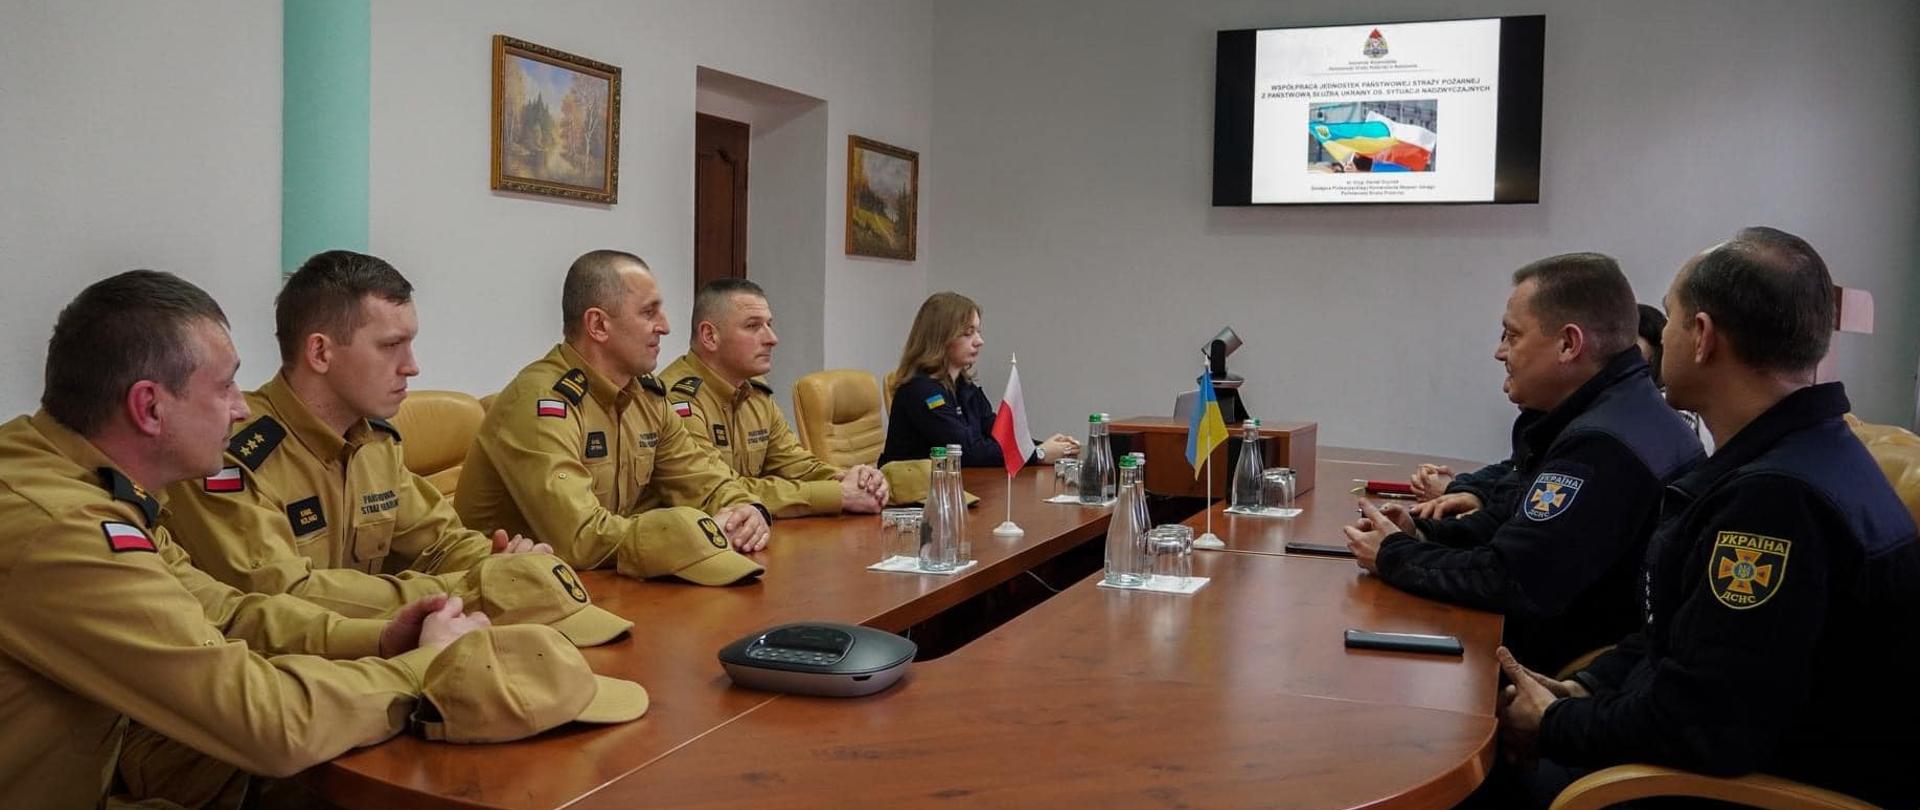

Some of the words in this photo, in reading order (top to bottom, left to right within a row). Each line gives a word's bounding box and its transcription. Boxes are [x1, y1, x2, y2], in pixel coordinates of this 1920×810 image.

[1320, 82, 1360, 90] JEDNOSTEK
[1341, 89, 1371, 97] UKRAINY
[1421, 86, 1490, 94] NADZWYCZAJNYCH
[1721, 534, 1785, 553] УКРАЇНА
[1720, 591, 1757, 604] ДСНС
